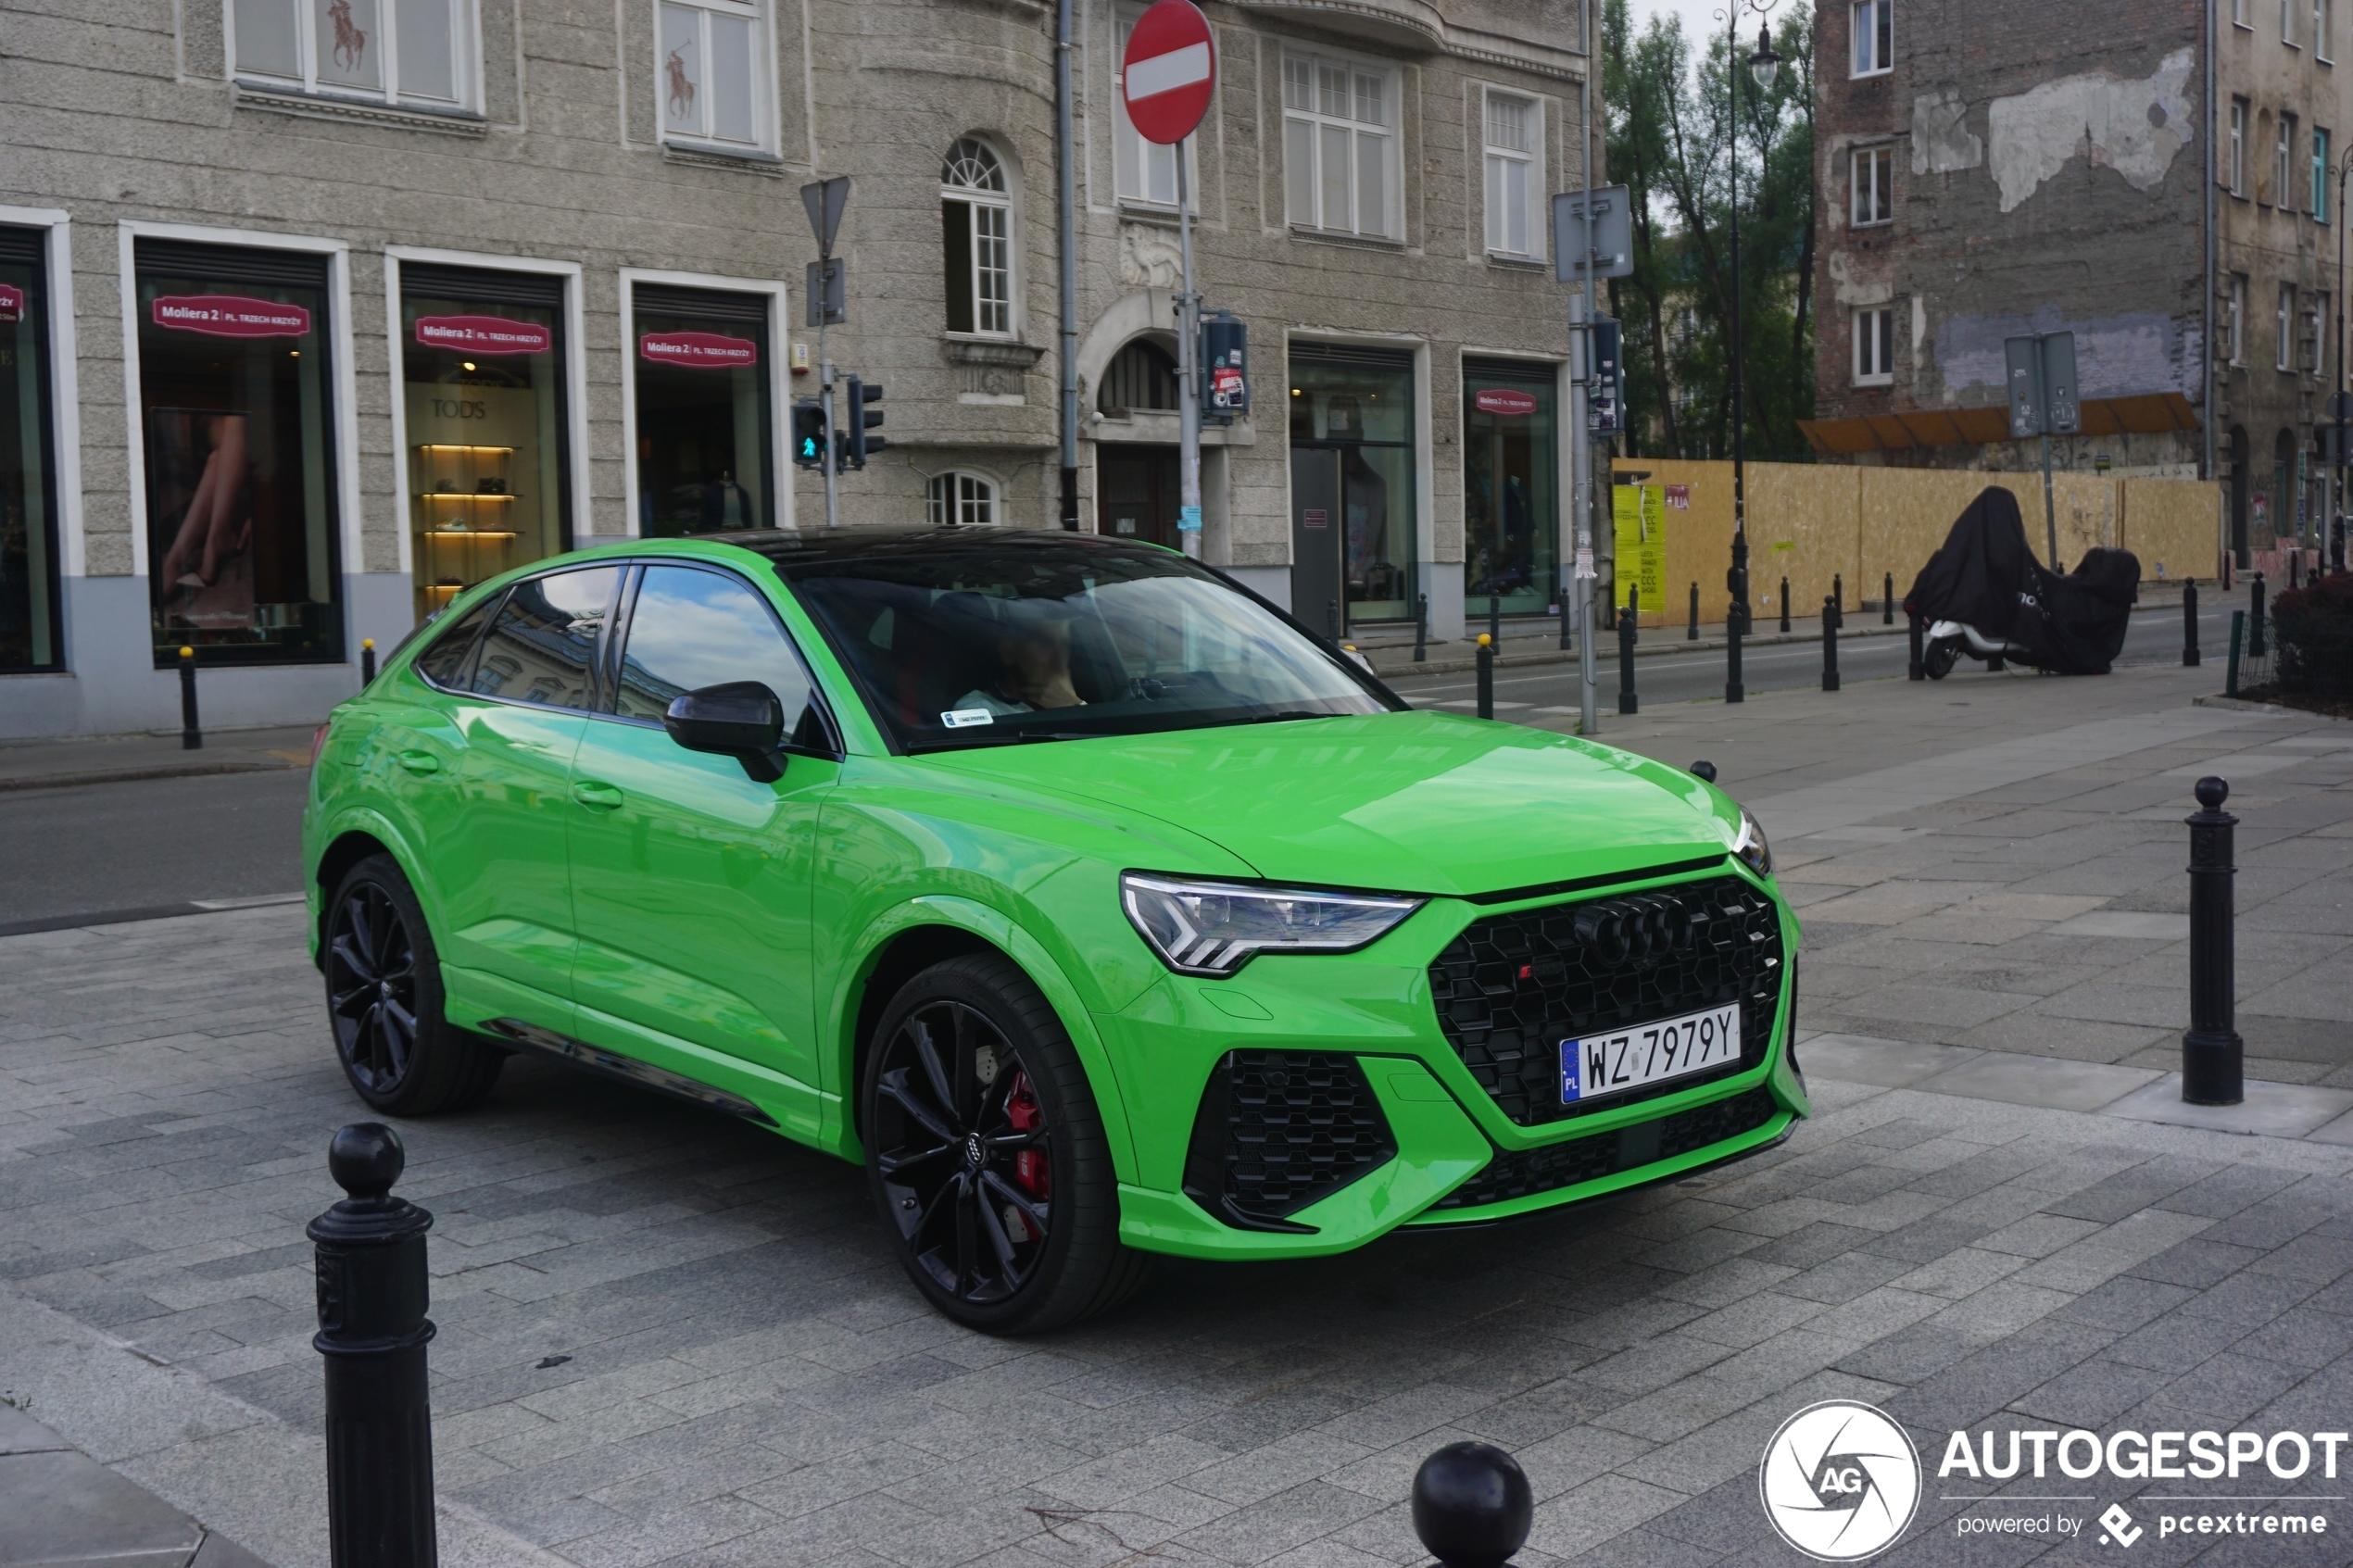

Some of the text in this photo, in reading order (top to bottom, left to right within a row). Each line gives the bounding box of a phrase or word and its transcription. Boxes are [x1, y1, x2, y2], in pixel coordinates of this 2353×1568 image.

[162, 306, 301, 326] Moliera 2 PL. TRZECH KRZYŻY
[423, 325, 543, 344] Moliera 2 PL. TRZECH KRZYŻY
[648, 342, 681, 353] Moliera
[683, 345, 689, 354] 2
[704, 347, 726, 356] TRZECH
[727, 348, 749, 357] KRZYŻY
[431, 398, 485, 420] TOD'S
[1642, 575, 1656, 585] CCC
[1587, 1010, 1732, 1090] WZ 7979Y
[1565, 1076, 1579, 1091] PL
